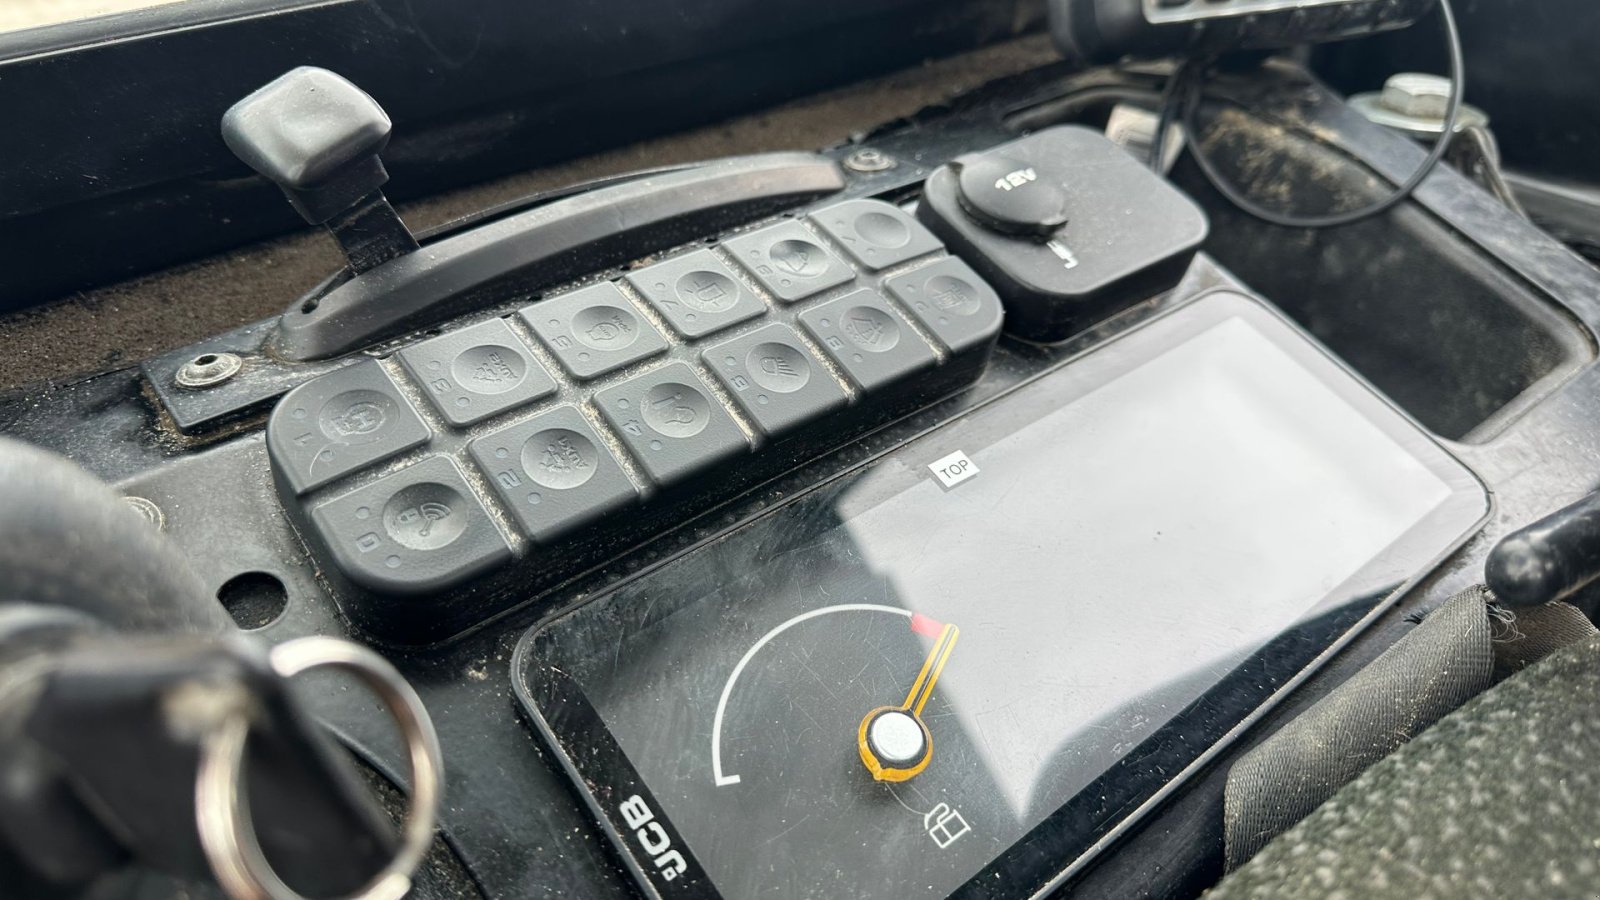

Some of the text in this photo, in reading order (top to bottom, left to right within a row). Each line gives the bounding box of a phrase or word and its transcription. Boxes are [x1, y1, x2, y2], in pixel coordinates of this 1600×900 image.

[995, 167, 1037, 191] 12V
[551, 335, 573, 350] 5
[430, 378, 452, 395] 3
[621, 419, 642, 436] 4
[293, 432, 313, 447] 1
[939, 459, 969, 479] TOP
[497, 468, 521, 490] 2
[619, 794, 688, 882] JCB
